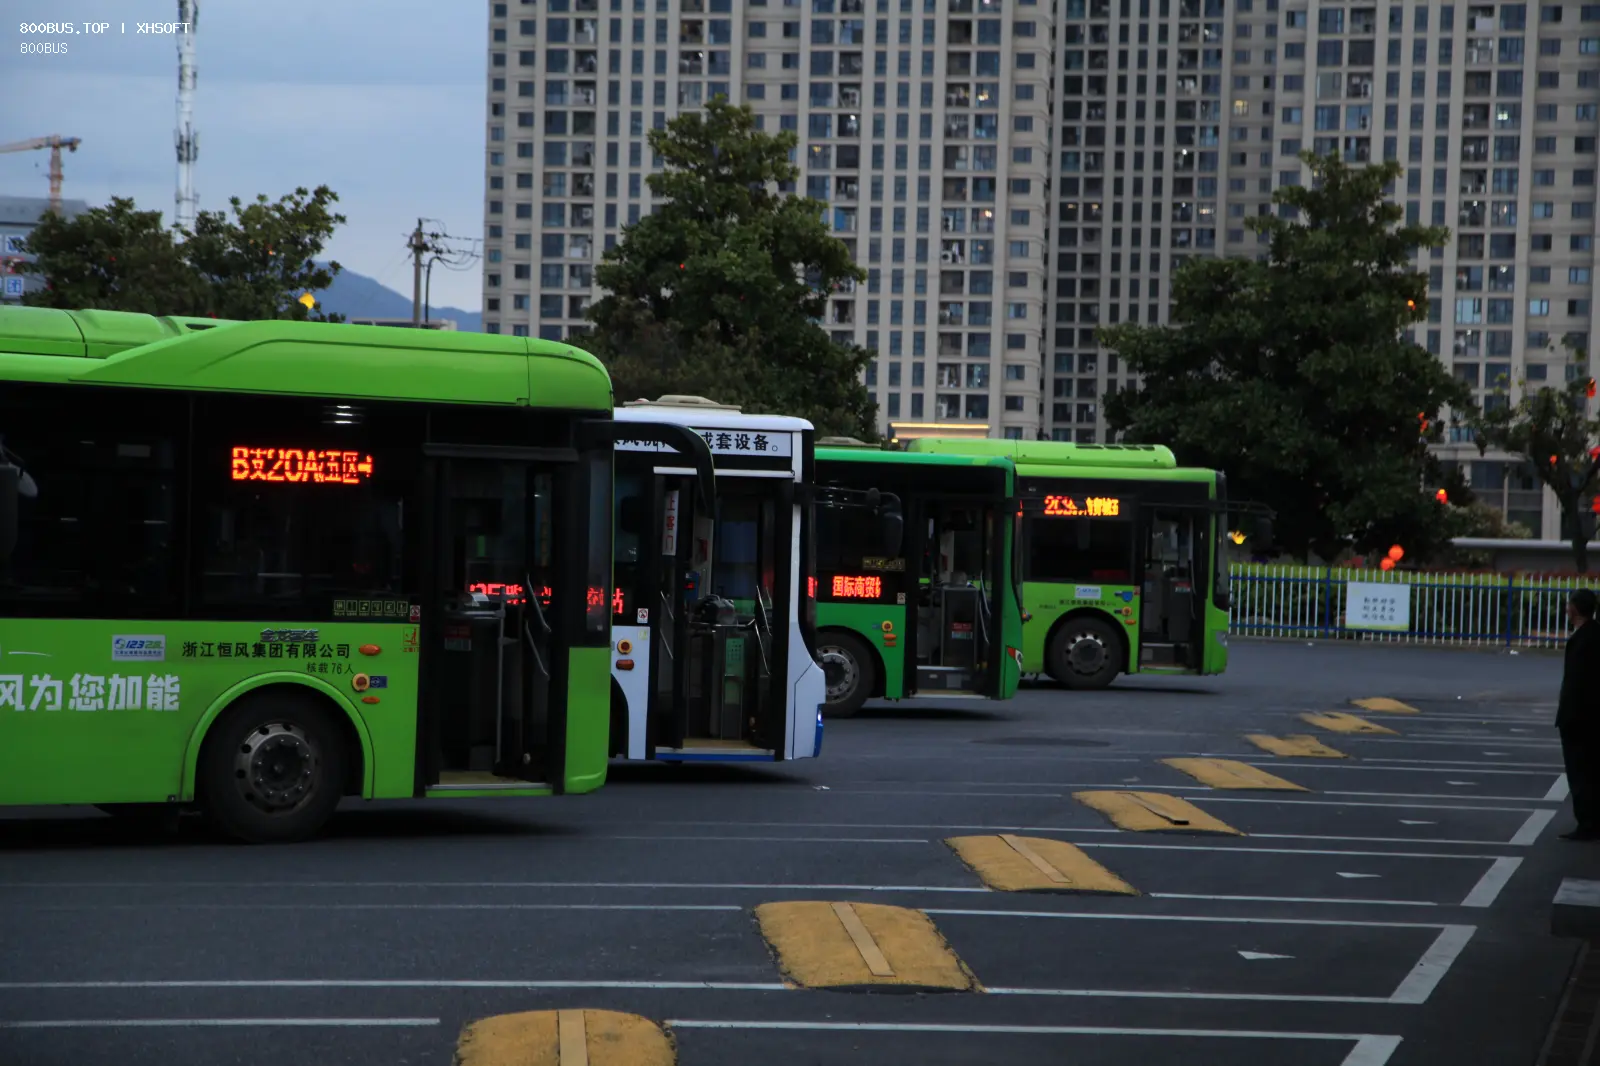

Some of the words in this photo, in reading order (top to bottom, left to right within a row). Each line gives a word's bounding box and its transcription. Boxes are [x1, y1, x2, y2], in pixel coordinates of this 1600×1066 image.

[182, 641, 351, 659] 浙江恒风集团有限公司
